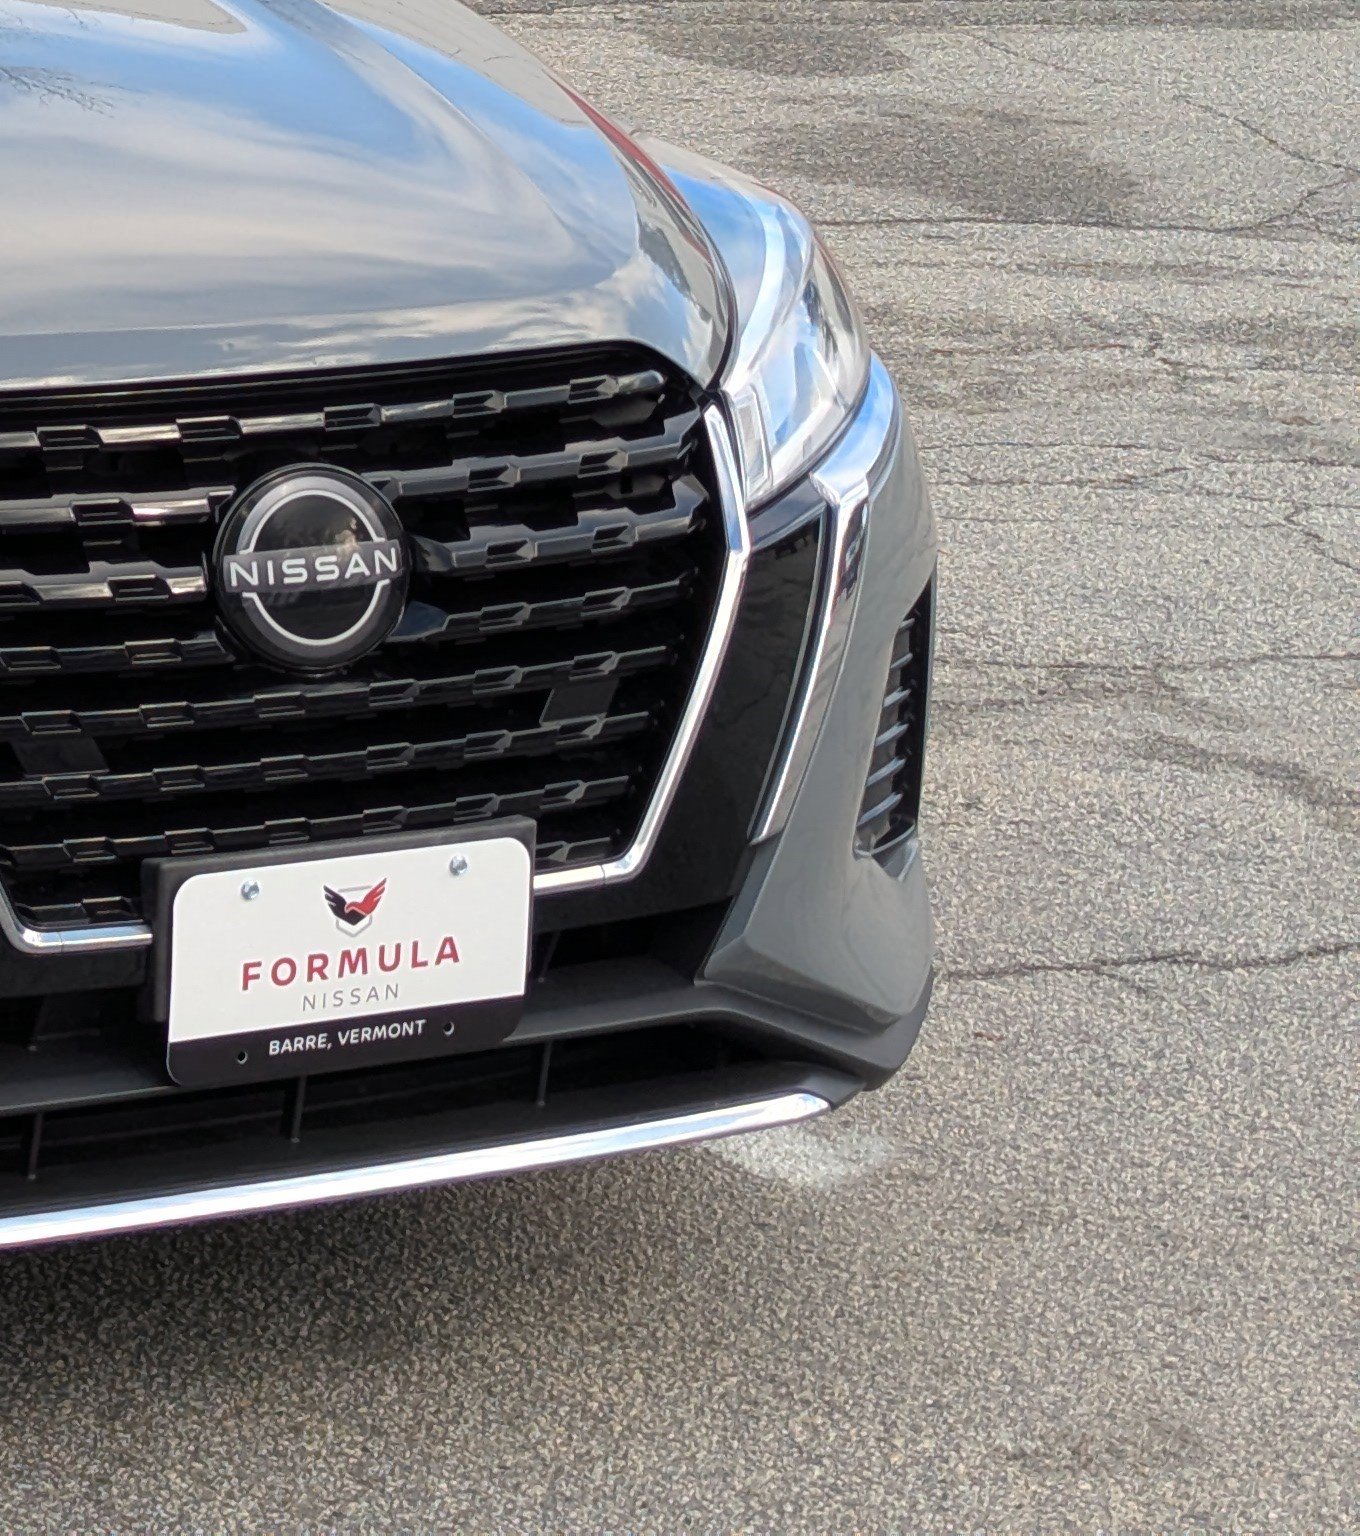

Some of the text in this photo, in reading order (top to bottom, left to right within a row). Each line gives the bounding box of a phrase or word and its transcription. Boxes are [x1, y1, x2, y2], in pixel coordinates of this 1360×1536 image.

[230, 547, 398, 587] NISSAN
[241, 936, 460, 991] FORMULA
[302, 983, 400, 1012] NISSAN
[268, 1019, 428, 1056] BARRE, VERMONT
